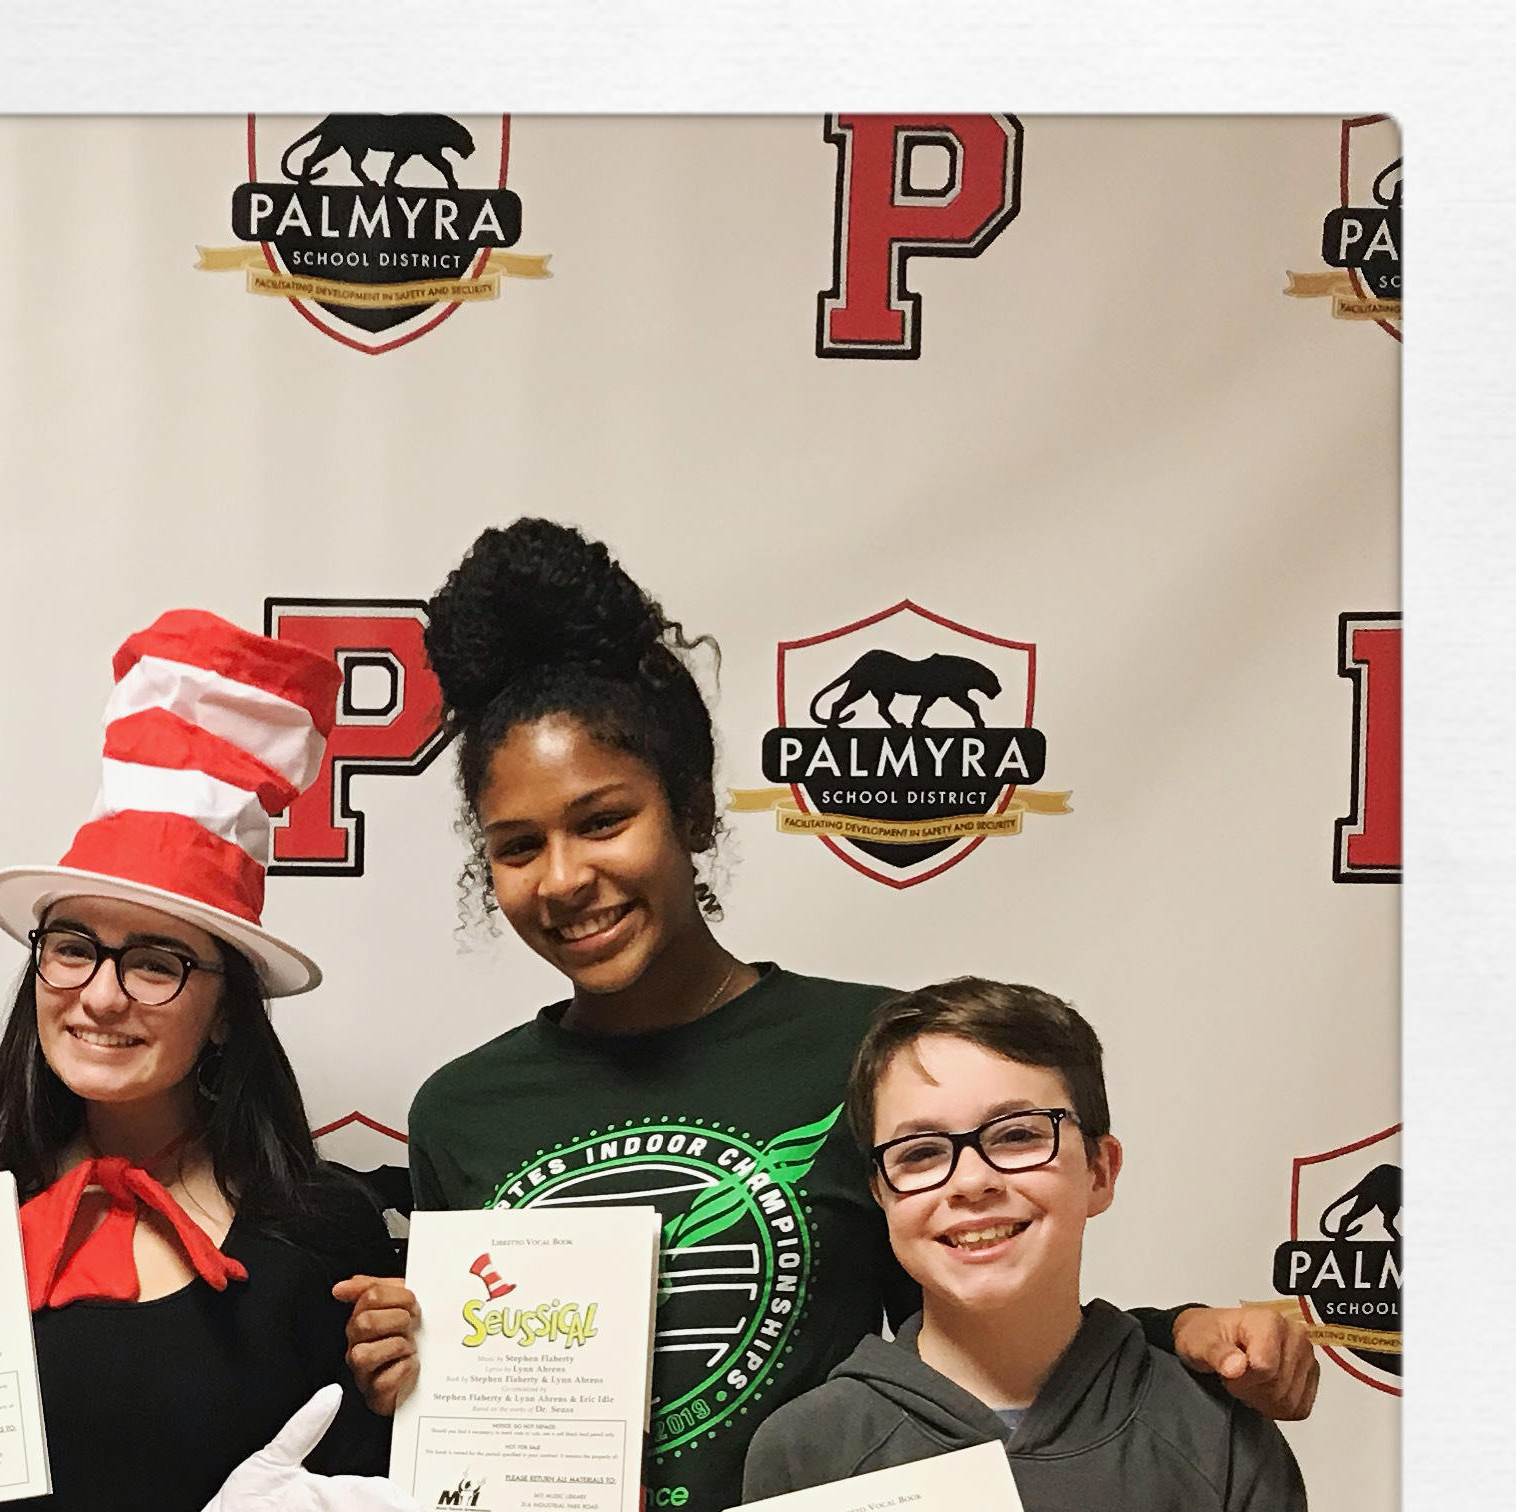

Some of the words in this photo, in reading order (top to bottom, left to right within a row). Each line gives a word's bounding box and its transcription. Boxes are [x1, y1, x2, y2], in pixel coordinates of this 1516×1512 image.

[250, 192, 505, 242] PALMYRA
[815, 113, 1024, 360] P
[293, 250, 369, 267] SCHOOL
[380, 252, 461, 269] DISTRICT
[264, 597, 456, 877] P
[779, 736, 1029, 778] PALMYRA
[822, 790, 898, 805] SCHOOL
[907, 791, 987, 805] DISTRICT
[784, 817, 843, 831] FACILITATING
[845, 821, 908, 838] DEVELOPMENT
[921, 825, 952, 837] SAFETY
[954, 821, 975, 833] AND
[976, 818, 1016, 831] SECURITY
[586, 1134, 709, 1163] INDOOR
[717, 1148, 801, 1391] CHAMPIONSHIPS
[1289, 1250, 1402, 1289] PALM
[1326, 1302, 1399, 1315] SCHOOL
[505, 1375, 538, 1383] Flaherty
[550, 1376, 571, 1384] Lynn
[469, 1394, 502, 1402] Flaherty
[655, 1398, 711, 1442] 2019
[568, 1476, 604, 1484] MATERIALS
[867, 1498, 896, 1511] VOCAL
[897, 1492, 921, 1503] BOOK
